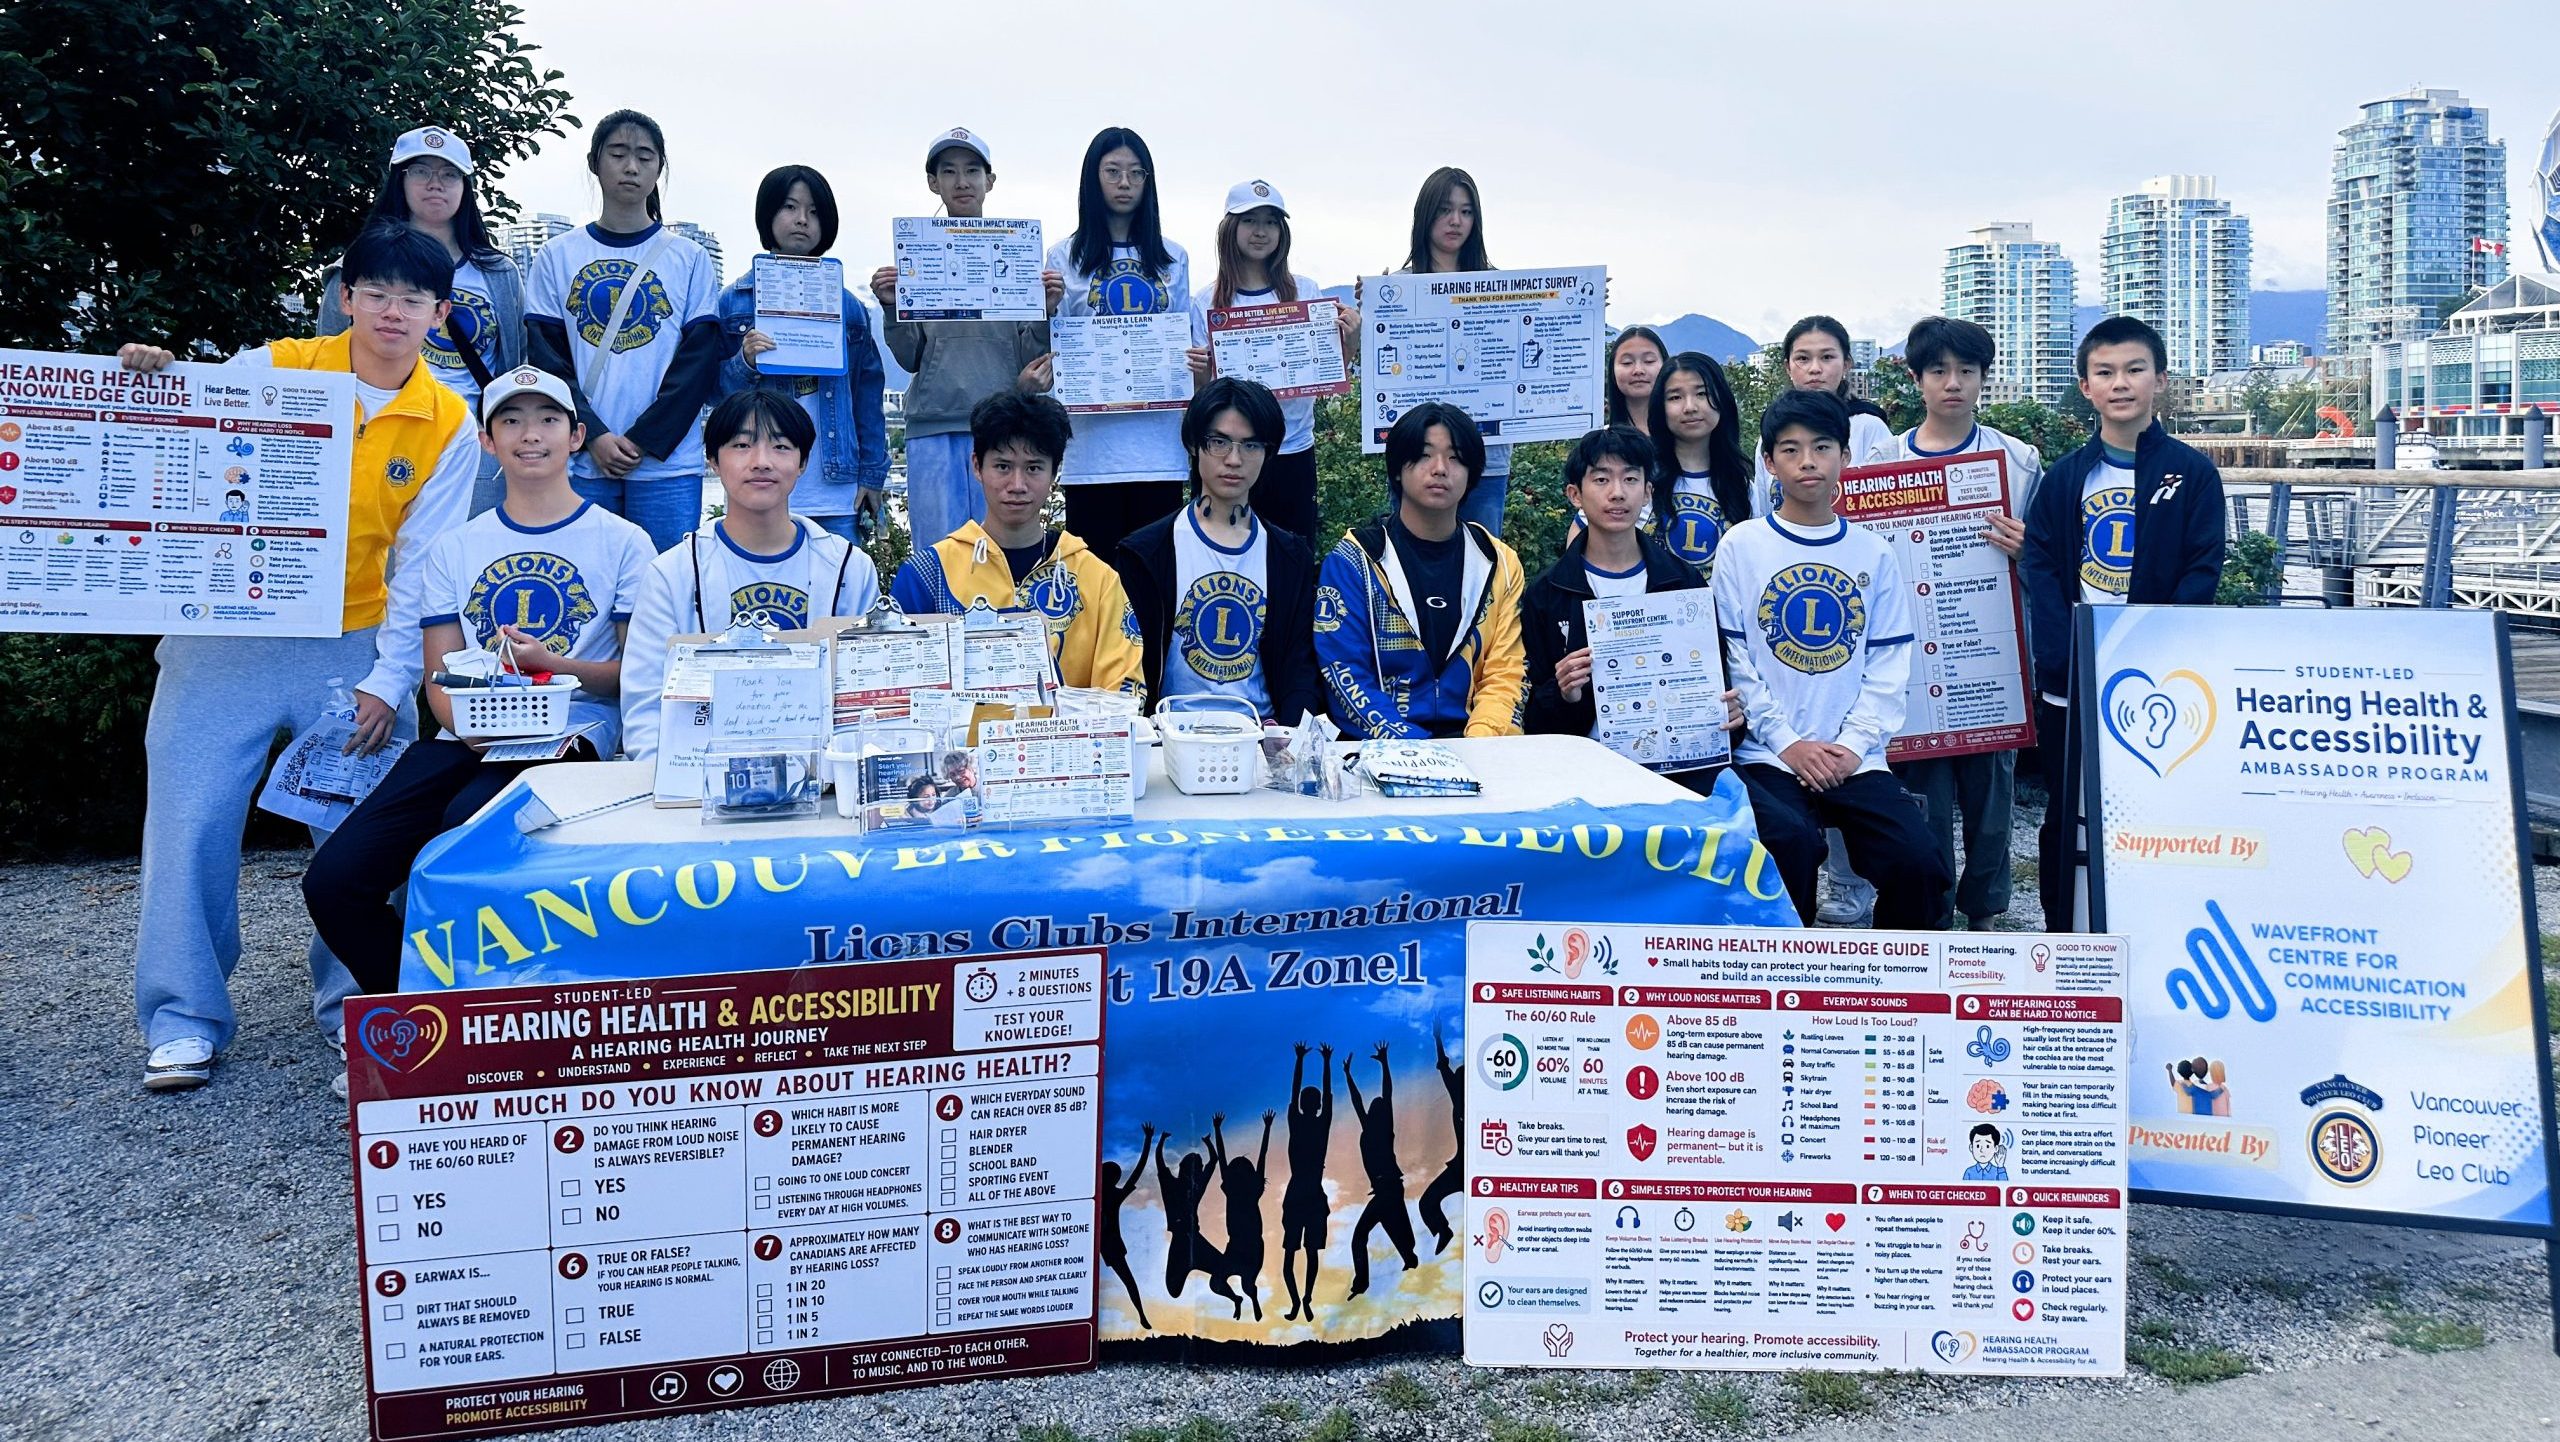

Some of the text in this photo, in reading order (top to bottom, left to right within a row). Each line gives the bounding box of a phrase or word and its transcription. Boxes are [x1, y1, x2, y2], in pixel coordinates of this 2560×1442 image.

[931, 219, 958, 227] HEARING
[1006, 220, 1028, 228] SURVEY
[1431, 276, 1577, 295] HEARING HEALTH IMPACT SURVEY
[1120, 283, 1143, 312] L
[102, 370, 185, 390] HEALTH
[205, 385, 250, 395] Hear Better.
[131, 390, 191, 407] GUIDE
[204, 397, 250, 408] Live Better.
[1844, 470, 1942, 495] HEARING HEALTH
[1846, 486, 1943, 511] & ACCESSIBILITY
[2088, 492, 2135, 512] LIO
[1682, 519, 1707, 553] L
[2107, 521, 2134, 557] L
[490, 557, 570, 580] LIONS
[2085, 566, 2129, 588] INTERNATI
[1196, 576, 1257, 602] LIONS
[1778, 567, 1849, 593] LIONS
[515, 589, 545, 628] L
[732, 587, 806, 611] LIONS
[1612, 609, 1644, 619] SUPPORT
[1613, 614, 1667, 625] WAVEFRONT CENTRE
[1802, 598, 1831, 636] L
[1213, 607, 1240, 646] L
[1191, 653, 1253, 676] INTERNATIONAL
[1780, 646, 1845, 667] INTERNATIONAL
[2294, 665, 2414, 680] STUDENT-LED
[2235, 686, 2488, 722] Hearing Health &
[2239, 720, 2481, 764] Accessibility
[729, 773, 747, 790] 10
[2240, 761, 2487, 782] AMBASSADOR PROGRAM
[2114, 831, 2259, 862] Supported By
[1645, 825, 1784, 901] CLU
[807, 883, 1523, 963] Lions Clubs International
[2251, 923, 2378, 944] WAVEFRONT
[1644, 936, 1930, 957] HEARING HEALTH KNOWLEDGE GUIDE
[1949, 945, 2016, 956] Protect Hearing.
[1948, 957, 1986, 966] Promote
[2268, 947, 2397, 969] CENTRE FOR
[1019, 967, 1078, 982] 2 MINUTES
[1152, 958, 1256, 999] 19A
[1268, 940, 1427, 988] Zone1
[1948, 970, 2005, 981] Accessibility.
[1018, 987, 1025, 997] 8
[1029, 982, 1091, 996] QUESTIONS
[1502, 988, 1600, 999] SAFE LISTENING HABITS
[2284, 972, 2465, 997] COMMUNICATION
[554, 987, 651, 1004] STUDENT-LED
[1646, 992, 1760, 1003] WHY LOUD NOISE MATTERS
[1823, 996, 1907, 1007] EVERYDAY SOUNDS
[462, 983, 940, 1045] HEARING HEALTH & ACCESSIBILITY
[994, 1010, 1063, 1025] TEST YOUR
[1505, 1010, 1595, 1023] The 60/60 Rule
[2300, 997, 2450, 1020] ACCESSIBILITY
[571, 1027, 828, 1060] A HEARING HEALTH JOURNEY
[985, 1024, 1071, 1042] KNOWLEDGE!
[467, 1040, 926, 1084] DISCOVER UNDERSTAND EXPERIENCE REFLECT TAKE THE NEXT STEP
[419, 1053, 1070, 1123] HOW MUCH DO YOU KNOW ABOUT HEARING HEALTH?
[2316, 1081, 2369, 1095] VANCOUVER
[2410, 1091, 2520, 1118] Vancouver
[408, 1134, 527, 1154] HAVE YOU HEARD OF
[2128, 1126, 2268, 1157] Presented By
[2339, 1124, 2350, 1167] LEO
[2413, 1125, 2490, 1148] Pioneer
[408, 1151, 514, 1170] THE 60/60 RULE?
[2417, 1160, 2511, 1186] Leo Club
[1500, 1182, 1578, 1193] HEALTHY EAR TIPS
[2033, 1192, 2109, 1202] QUICK REMINDERS
[413, 1192, 445, 1209] YES
[418, 1221, 442, 1237] NO
